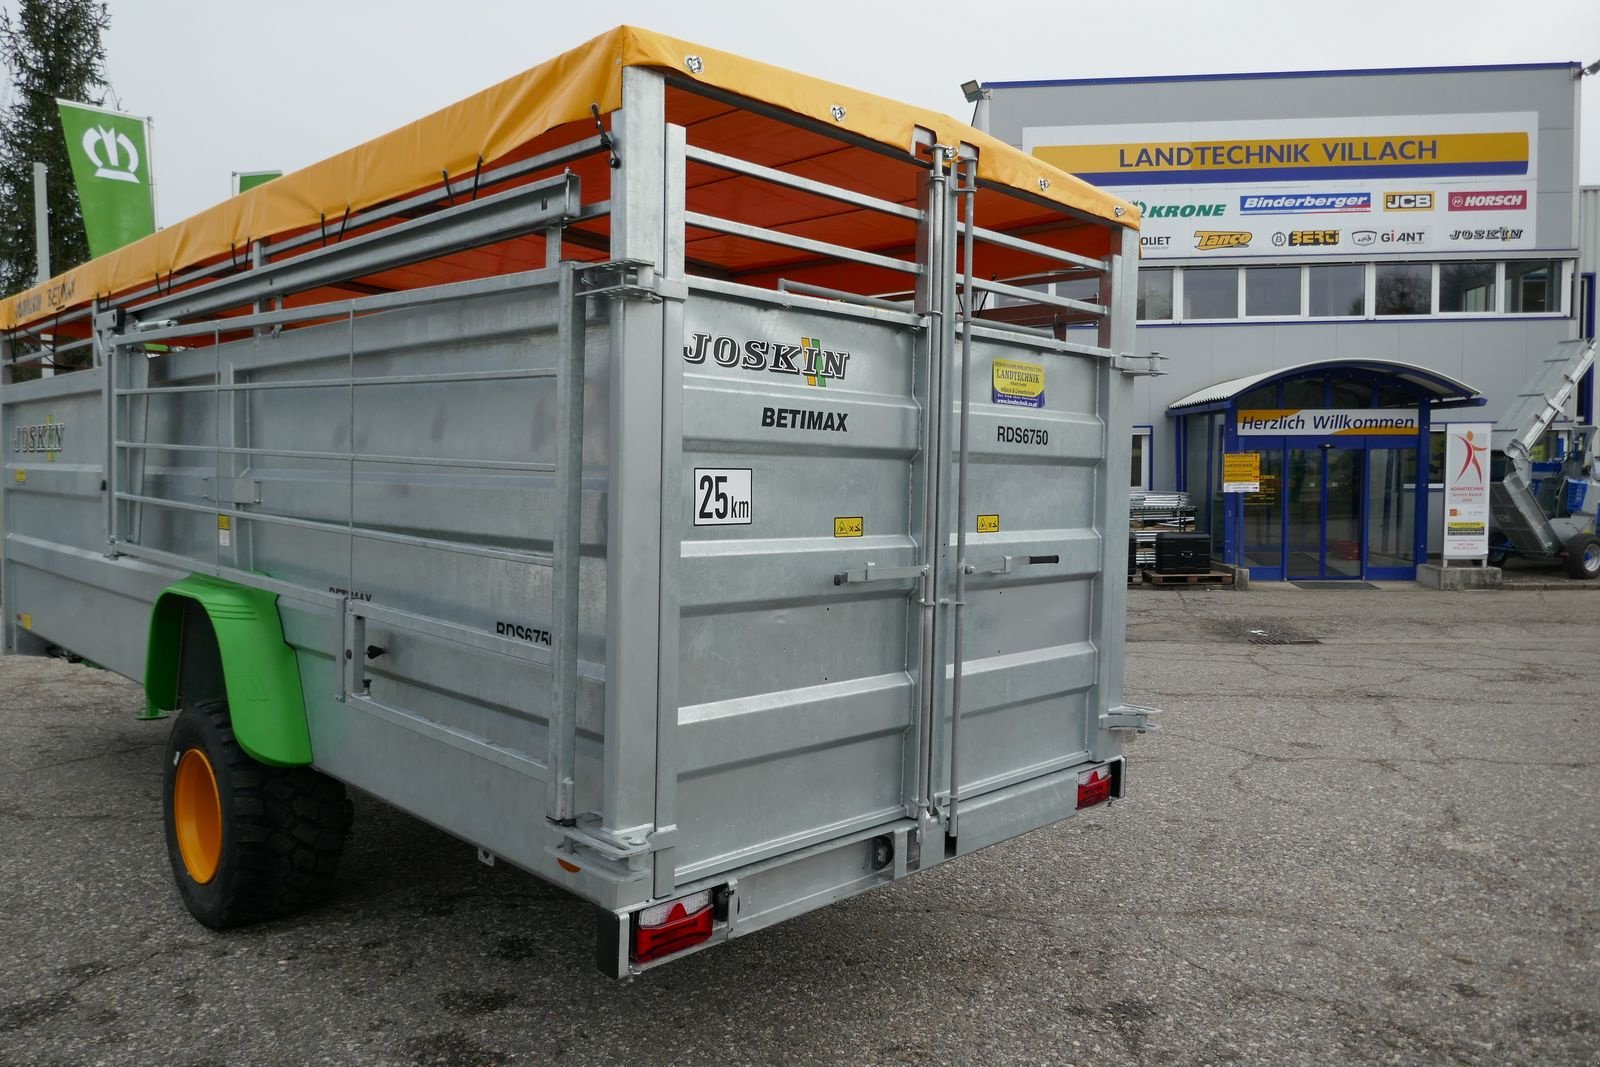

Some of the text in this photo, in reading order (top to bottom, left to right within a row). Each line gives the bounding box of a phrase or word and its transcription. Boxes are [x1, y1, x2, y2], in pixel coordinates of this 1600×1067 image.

[1119, 139, 1438, 168] LANDTECHNIK VILLACH
[1244, 195, 1369, 209] Binderberger
[1386, 194, 1432, 209] JCB
[1464, 194, 1523, 207] HORSCH
[1148, 203, 1227, 218] KRONE
[1193, 230, 1253, 251] Tanco
[1449, 228, 1524, 241] JOSKIN
[683, 333, 850, 380] JOSKIN
[996, 369, 1040, 384] LANDTECHNIK
[761, 407, 849, 432] BETIMAX
[1241, 414, 1415, 430] Herzlich Willkommen
[14, 423, 65, 453] JOSKIN
[997, 426, 1049, 446] RDS6750
[699, 475, 749, 519] 25 km
